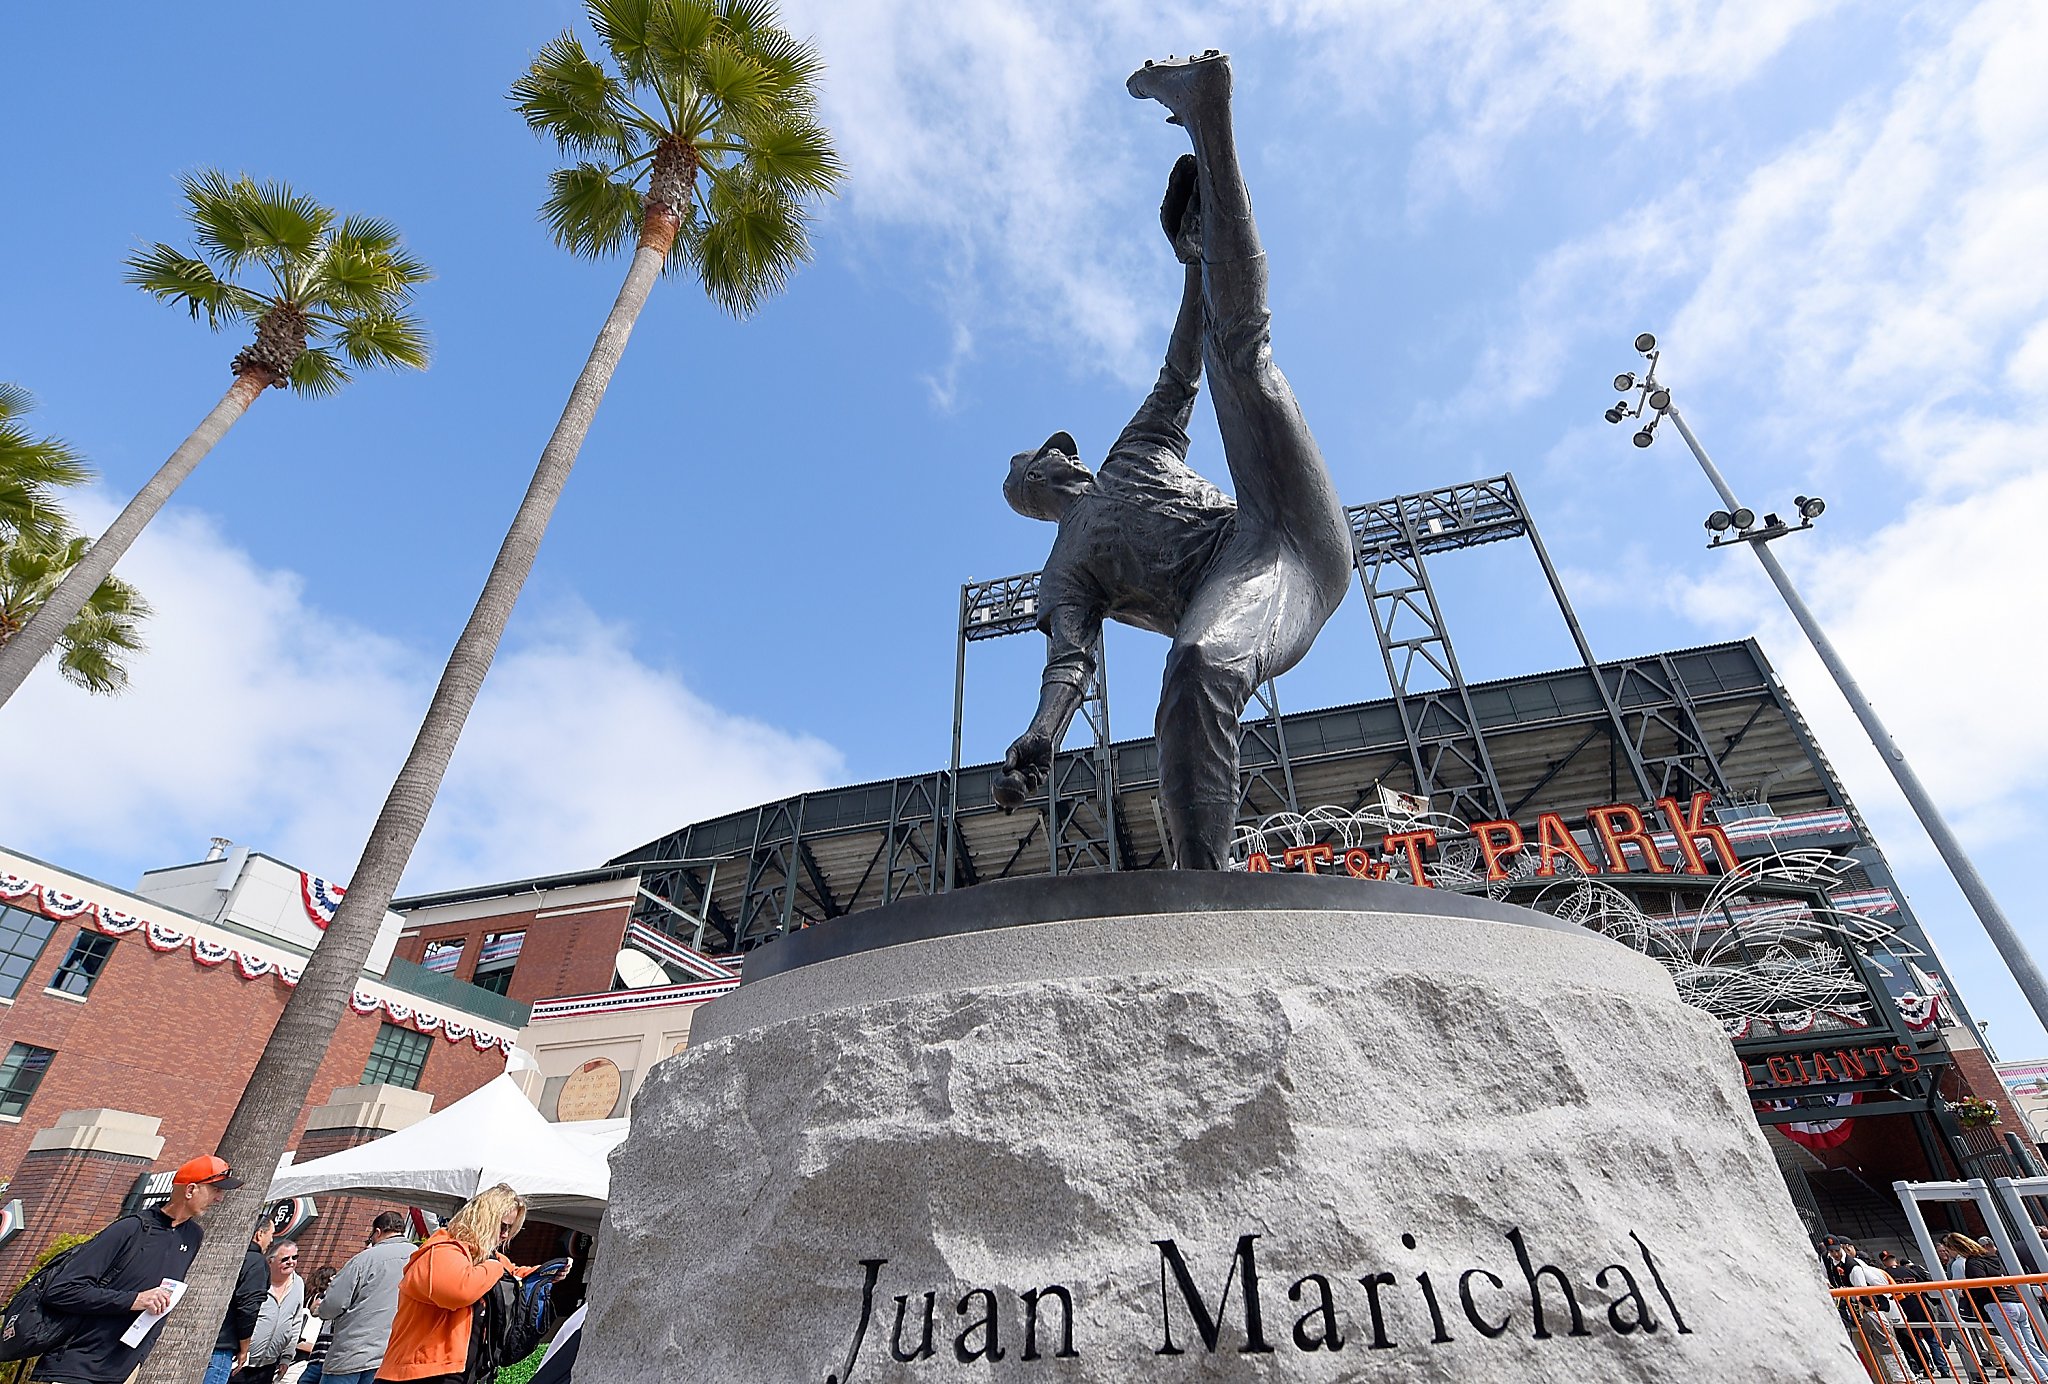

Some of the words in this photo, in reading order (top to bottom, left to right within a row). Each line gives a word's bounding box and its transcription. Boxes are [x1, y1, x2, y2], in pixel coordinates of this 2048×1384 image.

[1469, 791, 1751, 881] PARK
[1767, 1045, 1920, 1085] GIANTS
[826, 1258, 1080, 1384] Juan
[1150, 1226, 1693, 1355] Marichal
